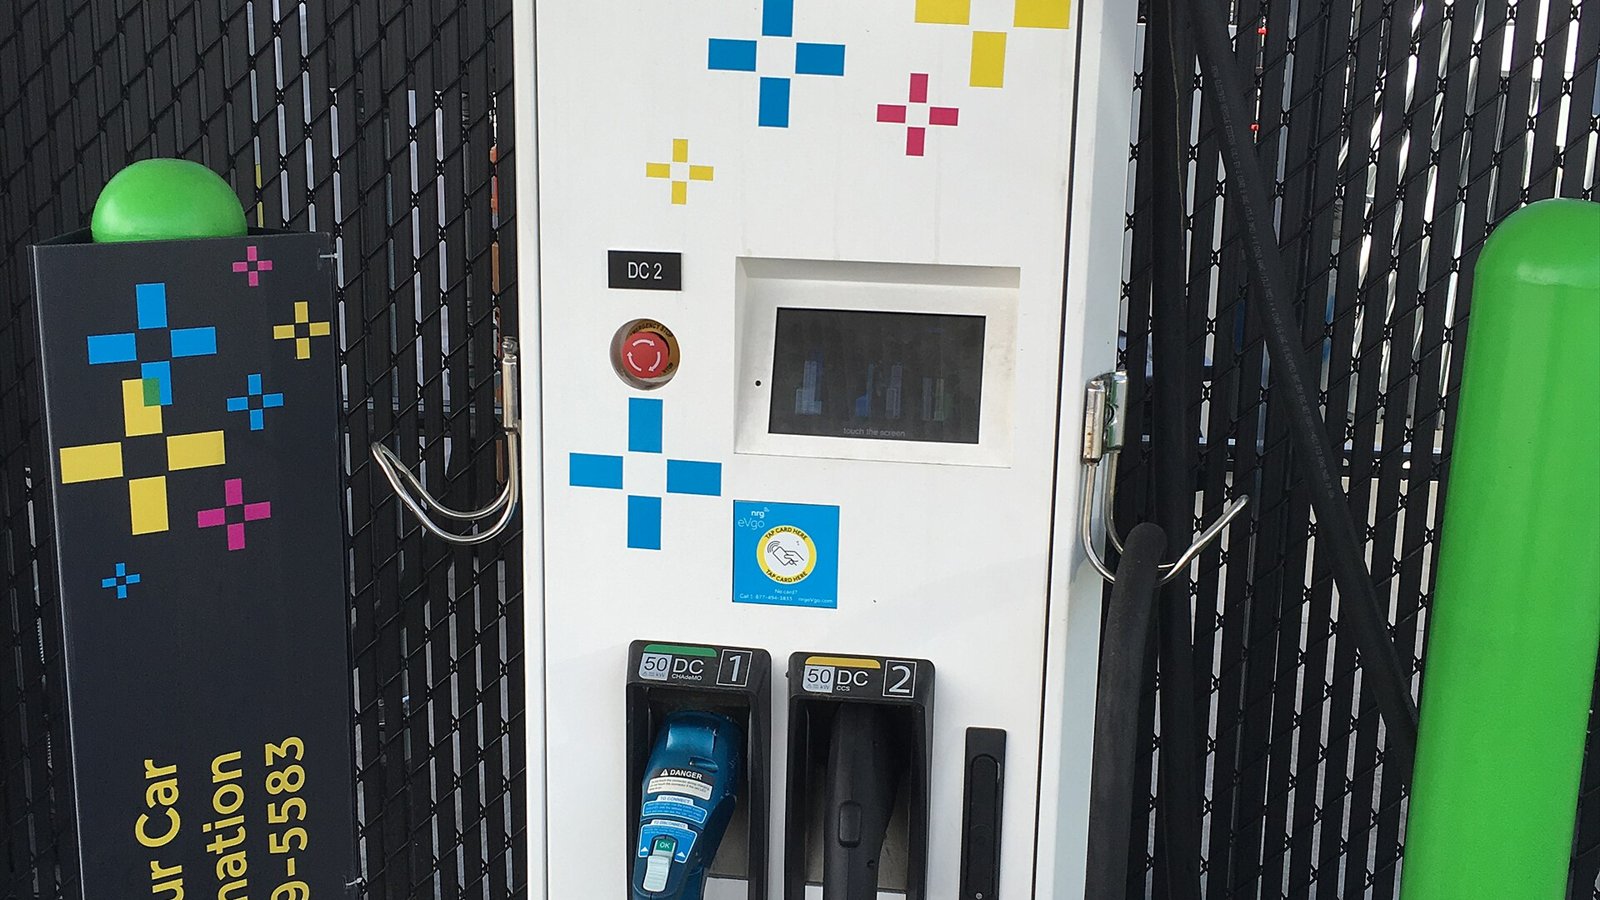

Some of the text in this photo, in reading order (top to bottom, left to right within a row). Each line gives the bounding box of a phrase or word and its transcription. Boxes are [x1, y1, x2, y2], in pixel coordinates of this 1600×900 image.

[627, 261, 663, 280] DC 2
[843, 427, 865, 435] touch
[866, 427, 879, 436] the
[751, 510, 765, 519] nrg
[737, 517, 765, 530] eVgo
[765, 530, 775, 539] TAP
[792, 529, 808, 540] HERE
[766, 569, 776, 578] TAP
[793, 571, 808, 581] HERE
[643, 656, 705, 675] 50 DC
[729, 655, 742, 682] 1
[671, 673, 703, 681] CHAdeMO
[807, 668, 869, 686] 50 DC
[888, 665, 911, 694] 2
[669, 769, 703, 780] DANGER
[135, 759, 181, 848] Car
